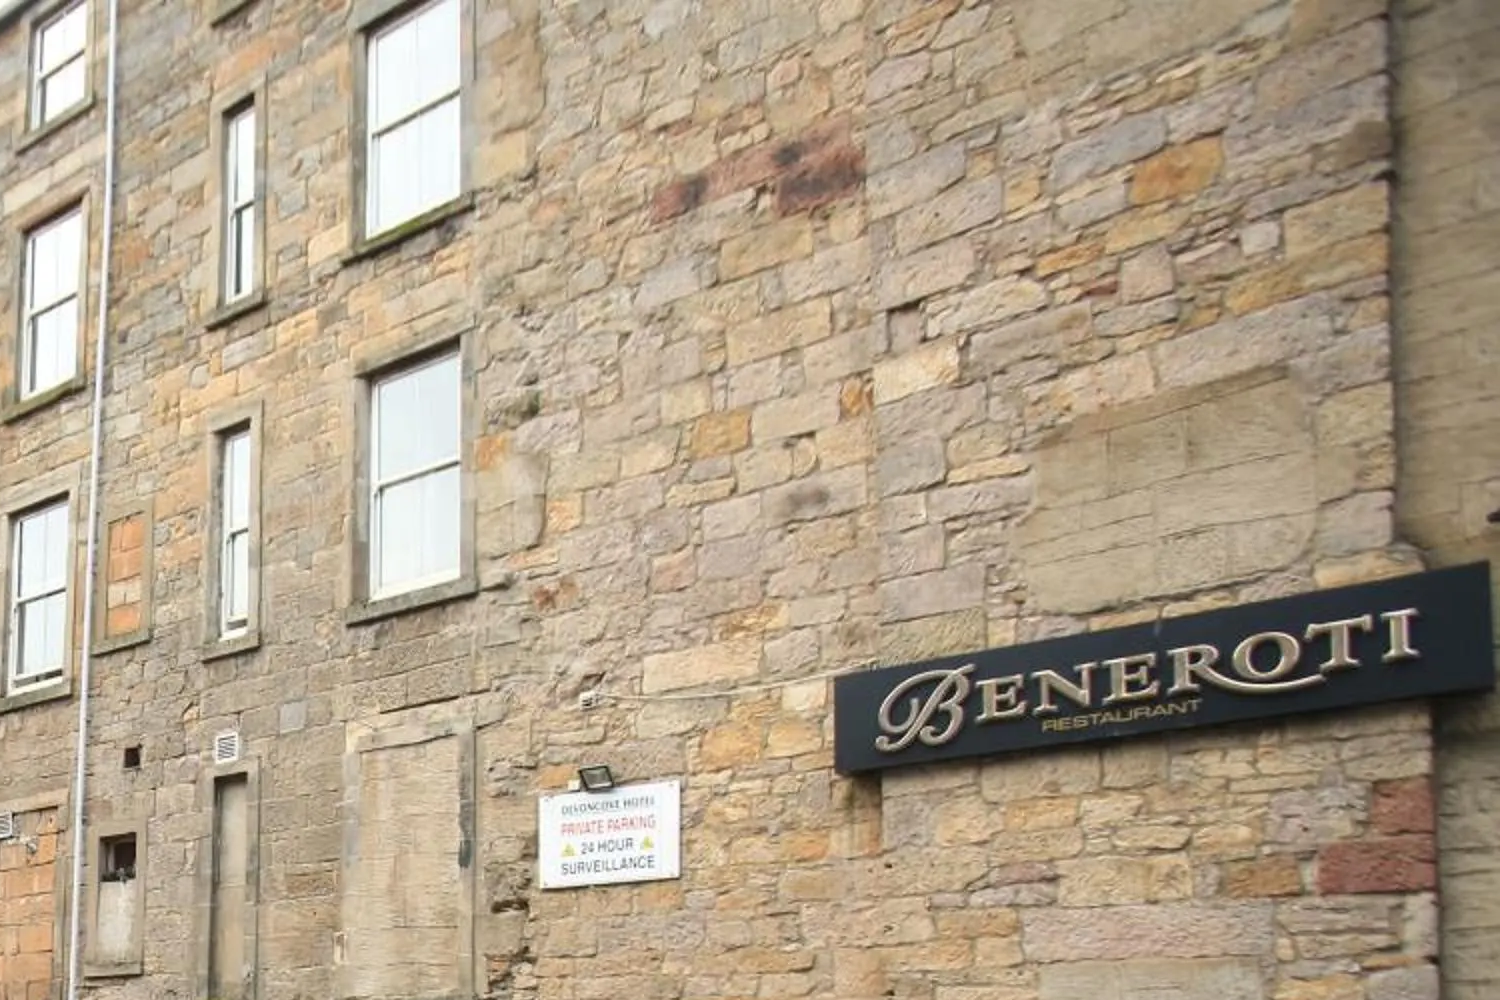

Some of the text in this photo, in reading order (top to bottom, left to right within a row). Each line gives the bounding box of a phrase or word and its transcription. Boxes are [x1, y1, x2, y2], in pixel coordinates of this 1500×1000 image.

[875, 608, 1421, 753] BENEROTI
[1042, 699, 1203, 733] RESTAURANT
[623, 795, 655, 810] HOTEL
[560, 814, 656, 837] PRIVATE PARKING
[581, 838, 634, 855] 24 HOUR
[560, 855, 655, 876] SURVEILLANCE
